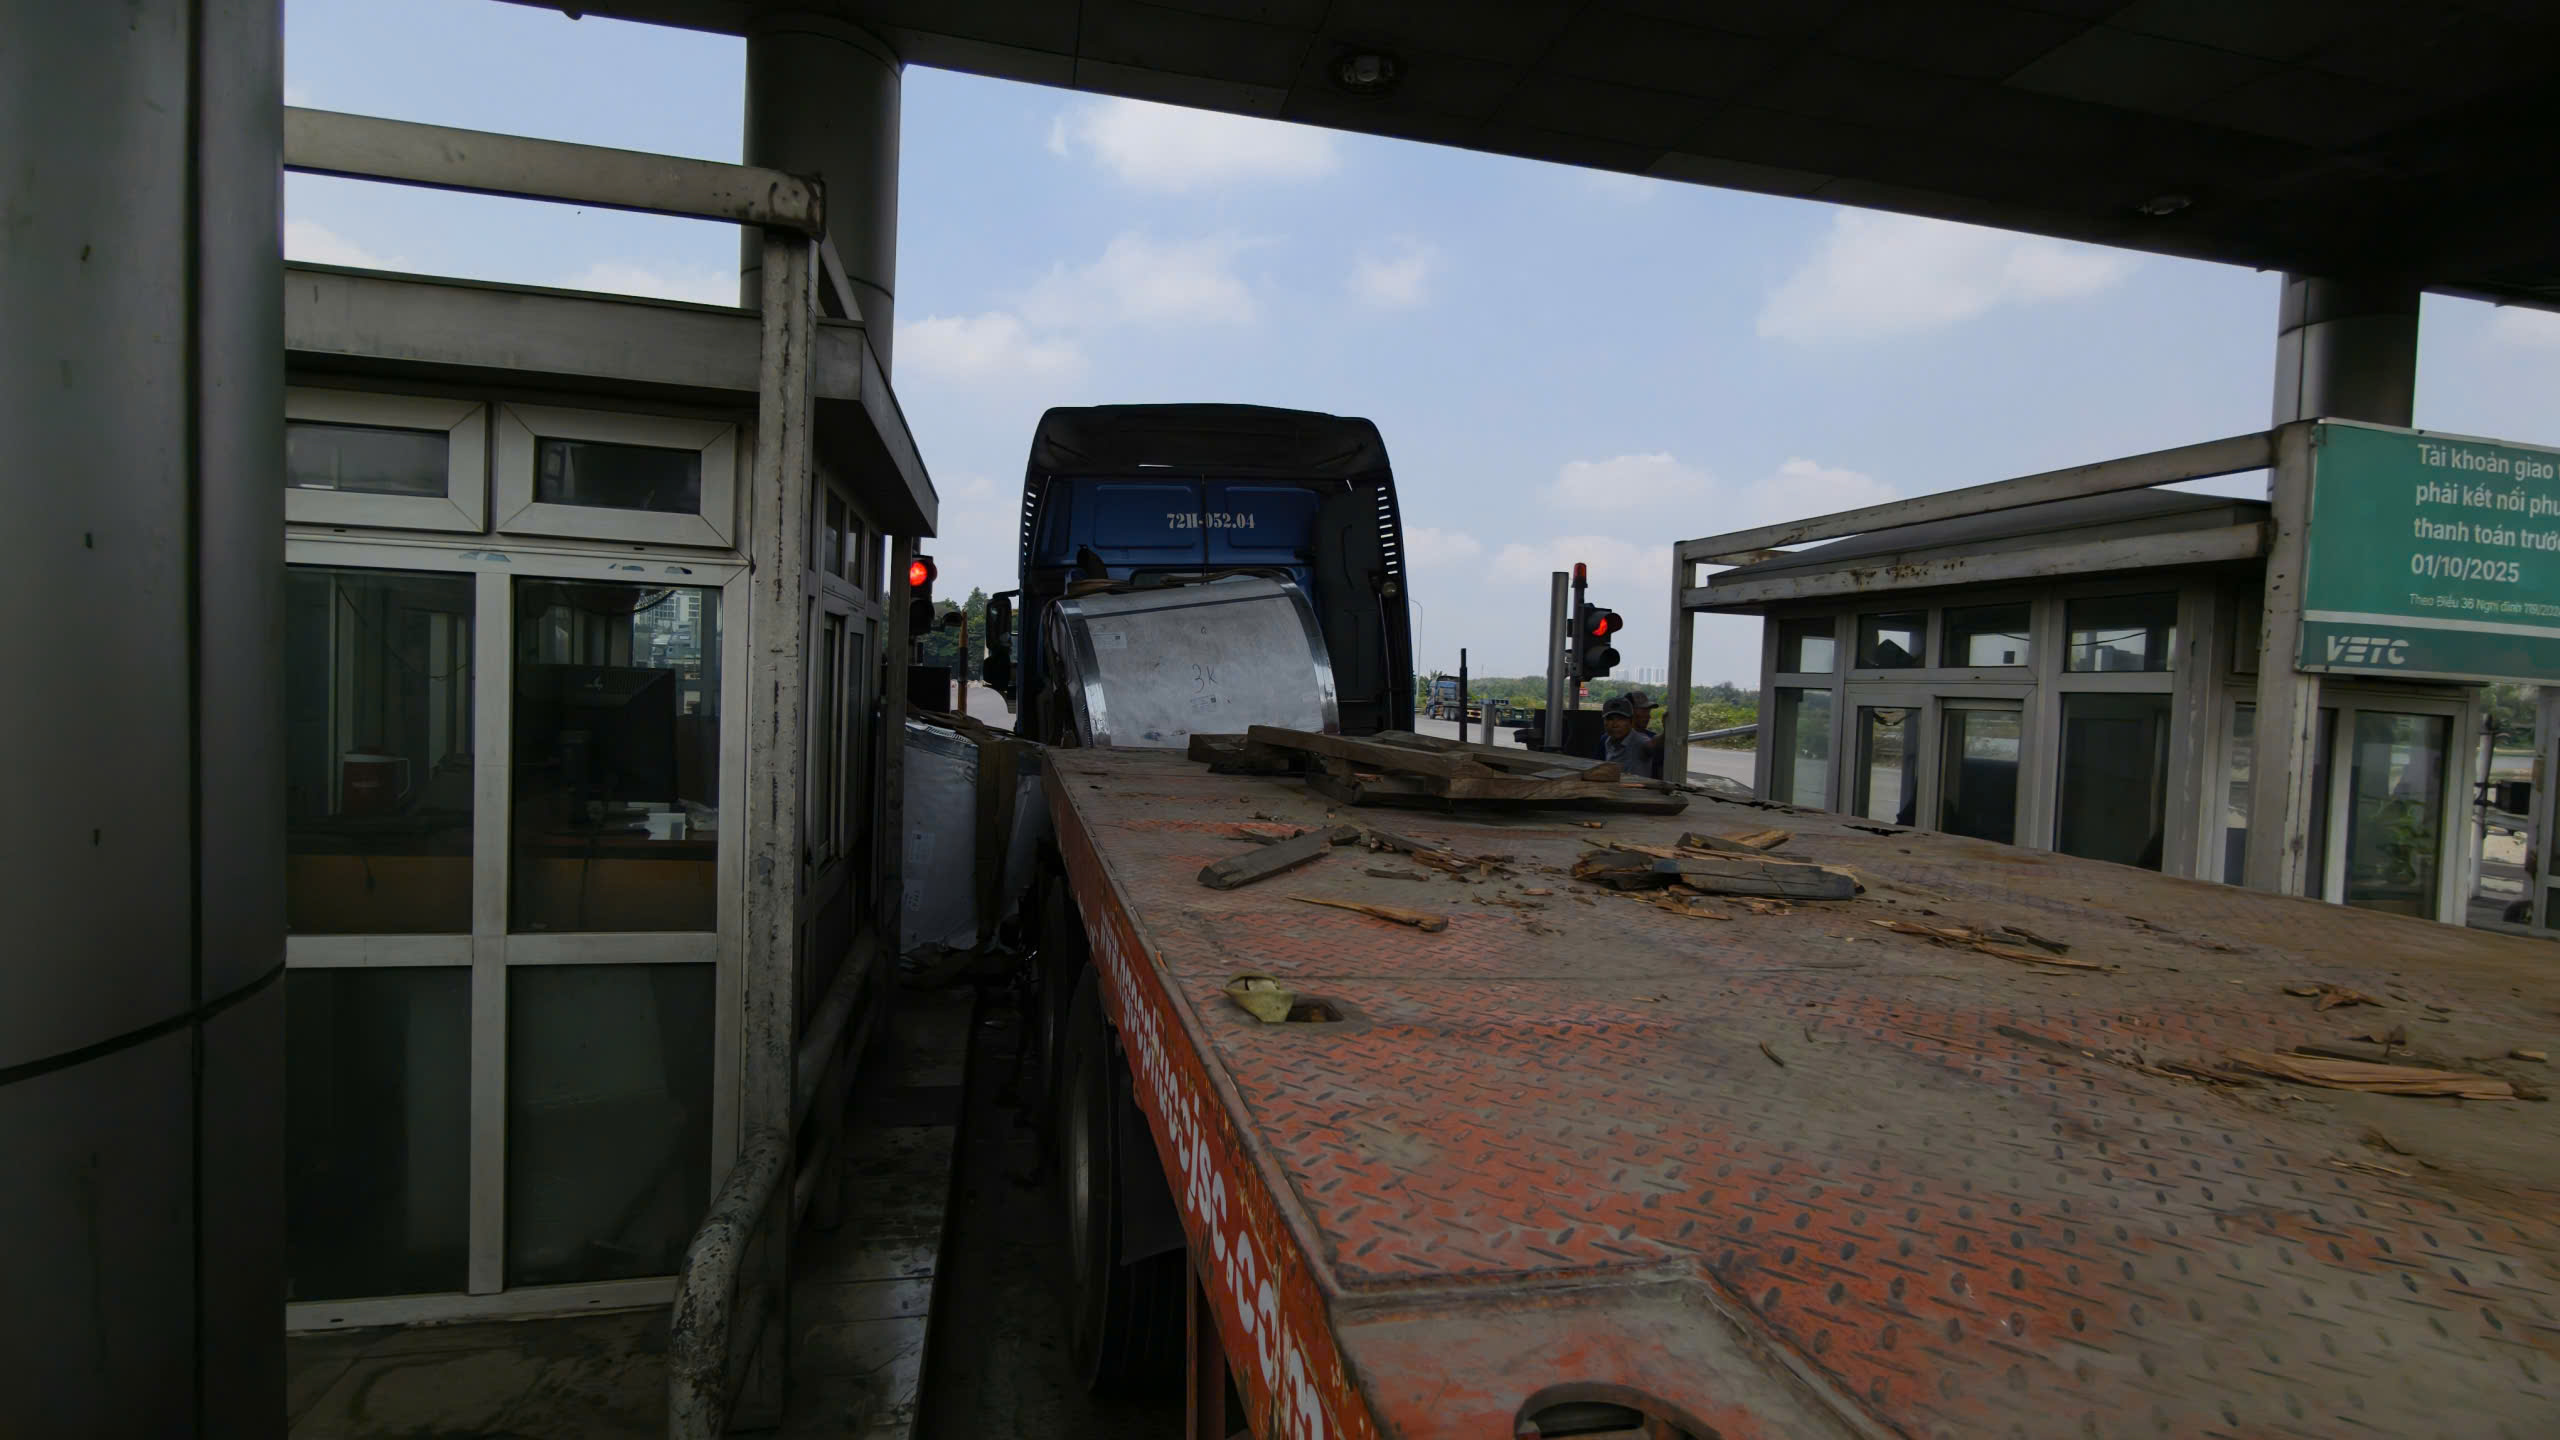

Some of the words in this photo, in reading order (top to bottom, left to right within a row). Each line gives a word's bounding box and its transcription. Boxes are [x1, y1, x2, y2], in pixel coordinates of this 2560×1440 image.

[2417, 443, 2447, 467] Tài
[2451, 447, 2509, 474] khoản
[2514, 456, 2554, 481] giao
[2416, 481, 2458, 506] phải
[2463, 483, 2493, 508] kết
[2496, 487, 2525, 512] nối
[1166, 512, 1256, 529] 72H-052.04
[2414, 517, 2469, 542] thanh
[2474, 524, 2516, 546] toán
[2521, 528, 2560, 551] trướ
[2411, 553, 2521, 583] 01/10/2025
[2327, 635, 2410, 665] VETC
